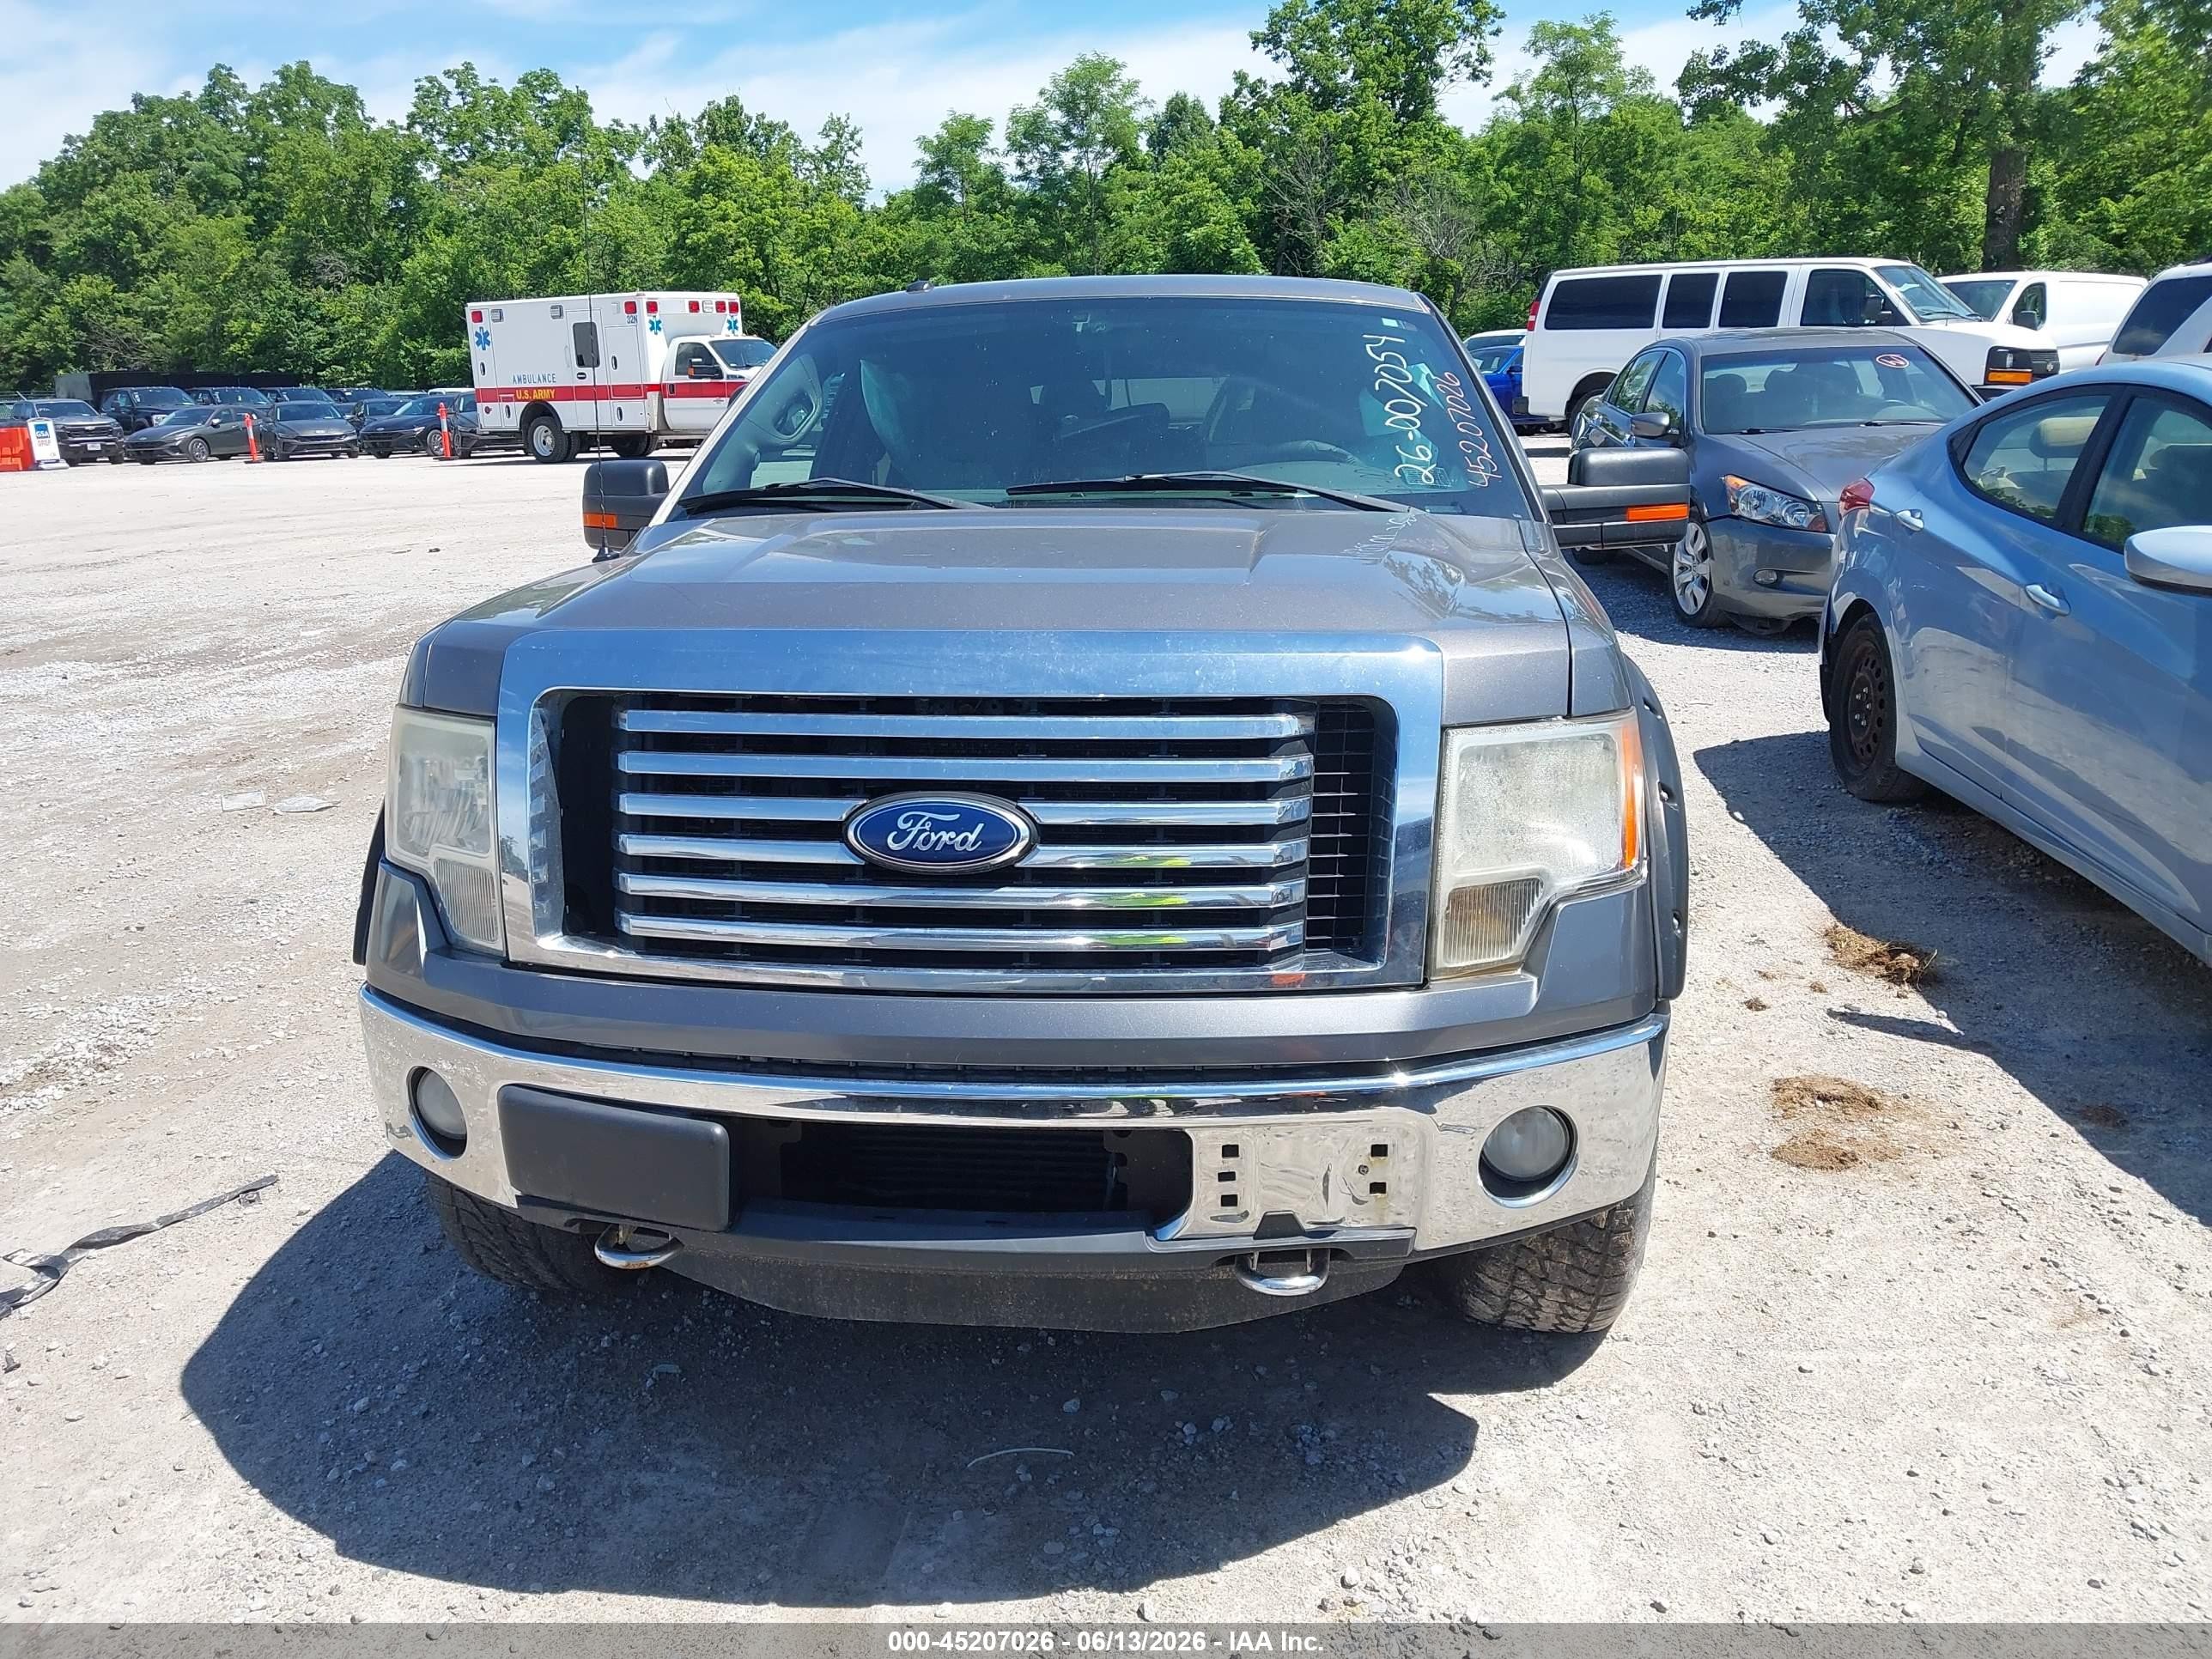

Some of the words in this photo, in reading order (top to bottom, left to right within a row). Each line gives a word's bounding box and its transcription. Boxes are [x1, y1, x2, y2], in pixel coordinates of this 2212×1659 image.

[626, 315, 638, 324] 32N
[513, 373, 556, 384] AMBULANCE
[515, 389, 532, 399] U.S.
[532, 388, 556, 399] ARMY
[1425, 371, 1503, 488] 45207026
[887, 811, 984, 851] Ford
